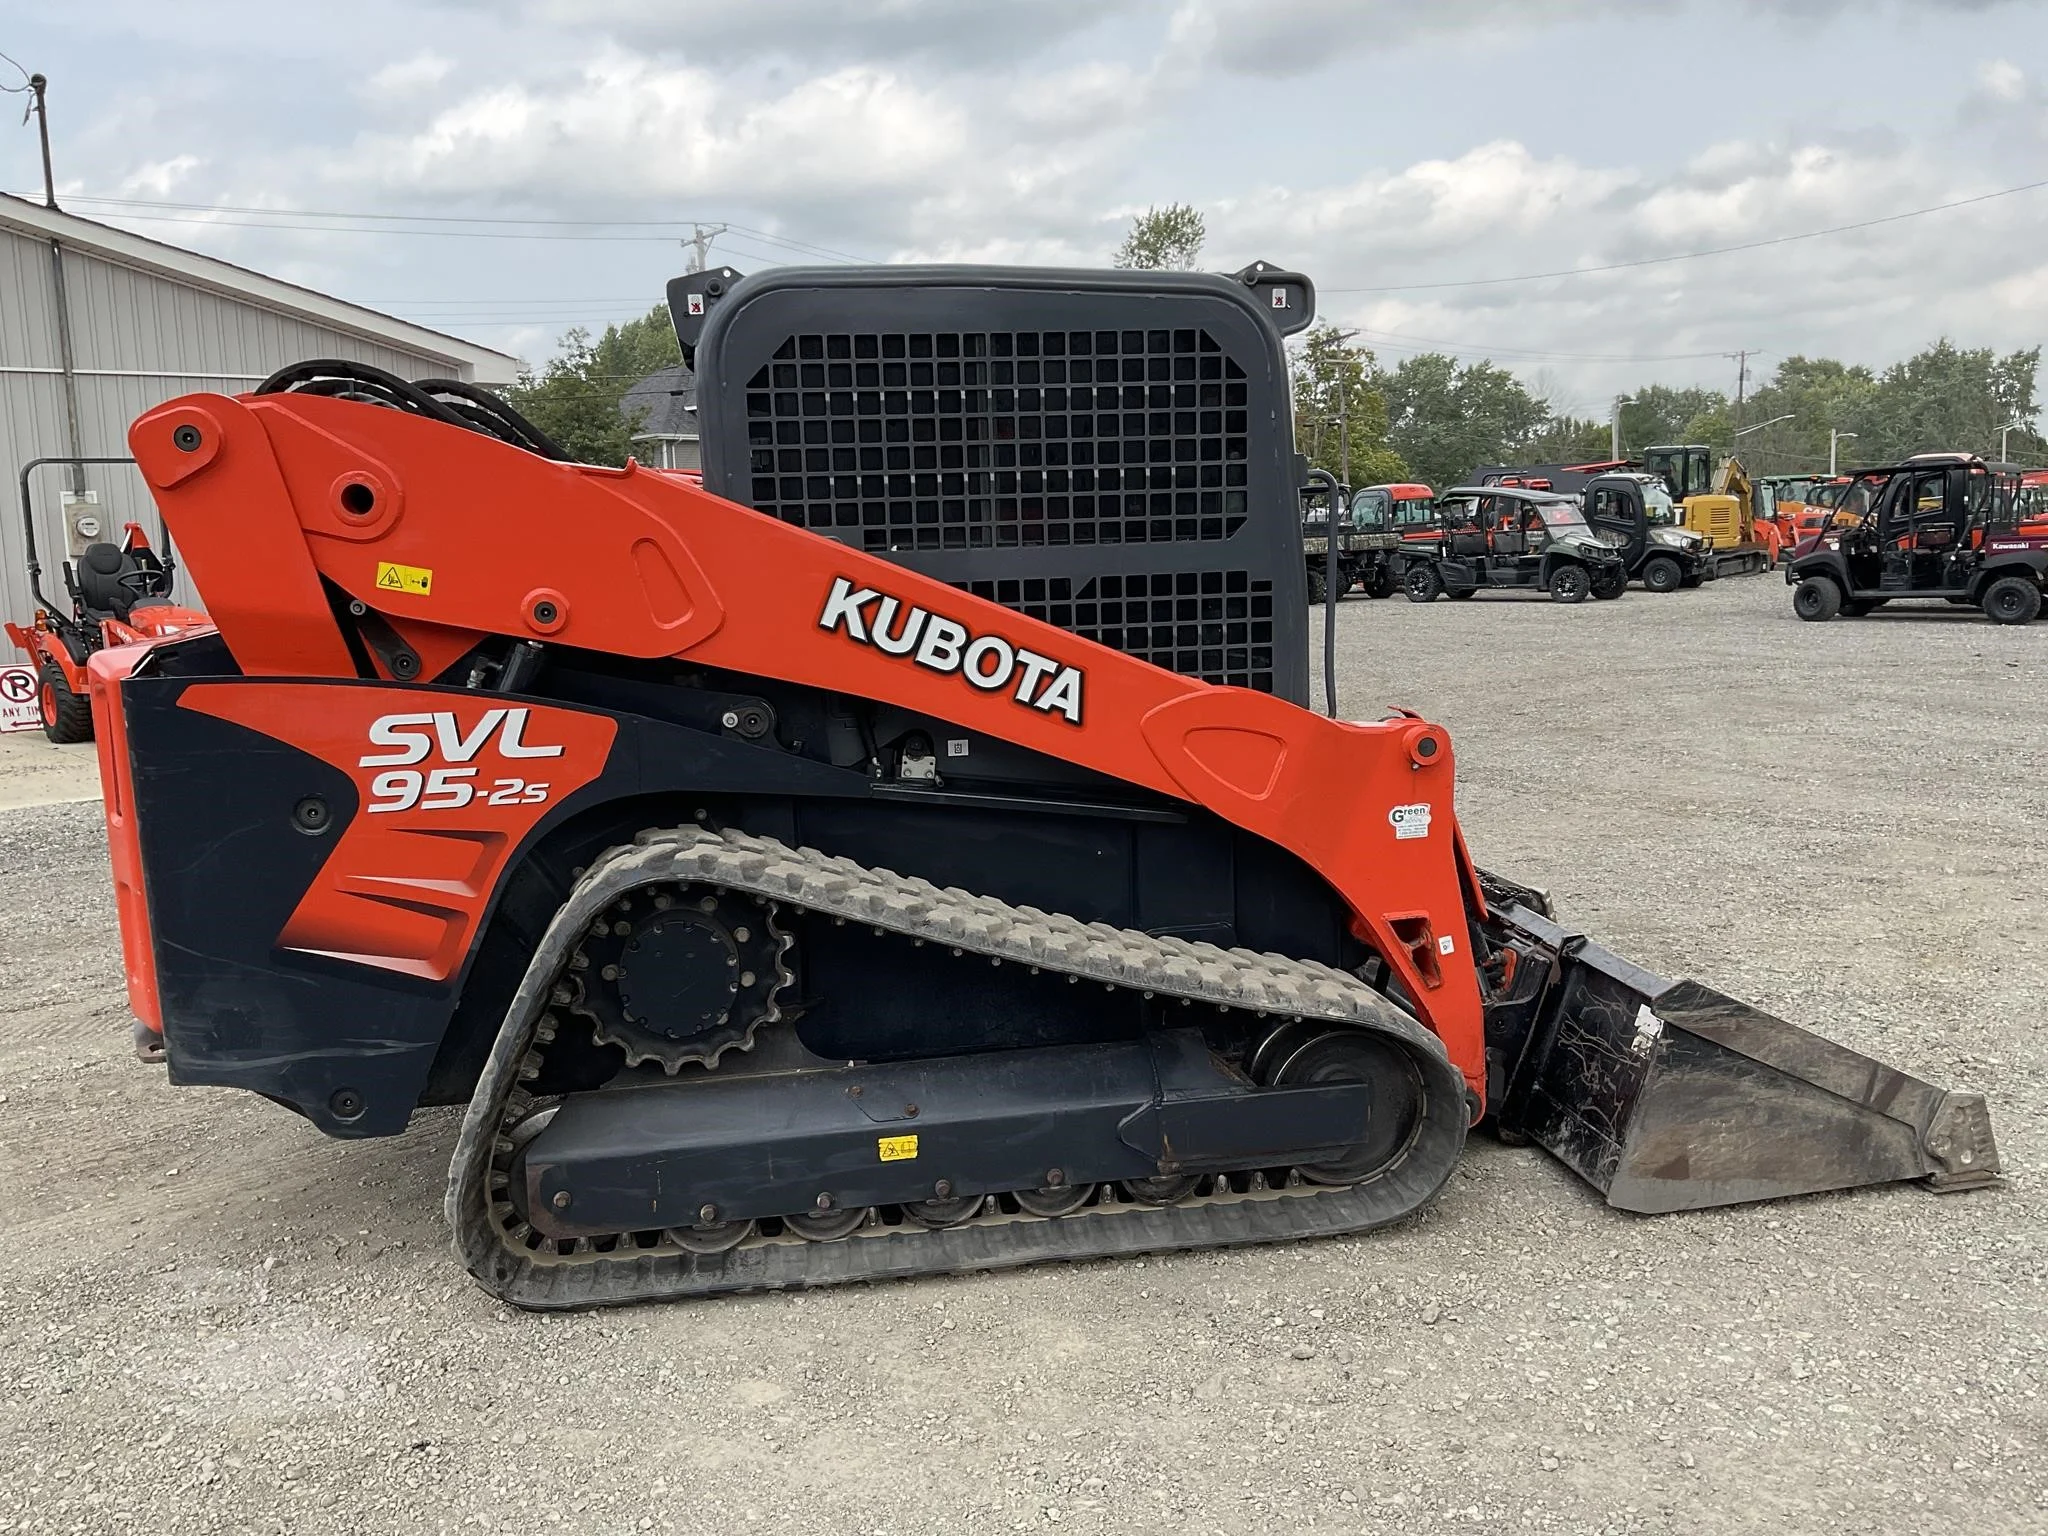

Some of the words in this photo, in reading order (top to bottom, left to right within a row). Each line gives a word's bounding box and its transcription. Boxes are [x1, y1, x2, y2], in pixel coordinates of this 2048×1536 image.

[819, 577, 1081, 723] KUBOTA
[2, 707, 20, 718] ANY
[358, 707, 564, 767] SVL
[1392, 807, 1426, 823] Green
